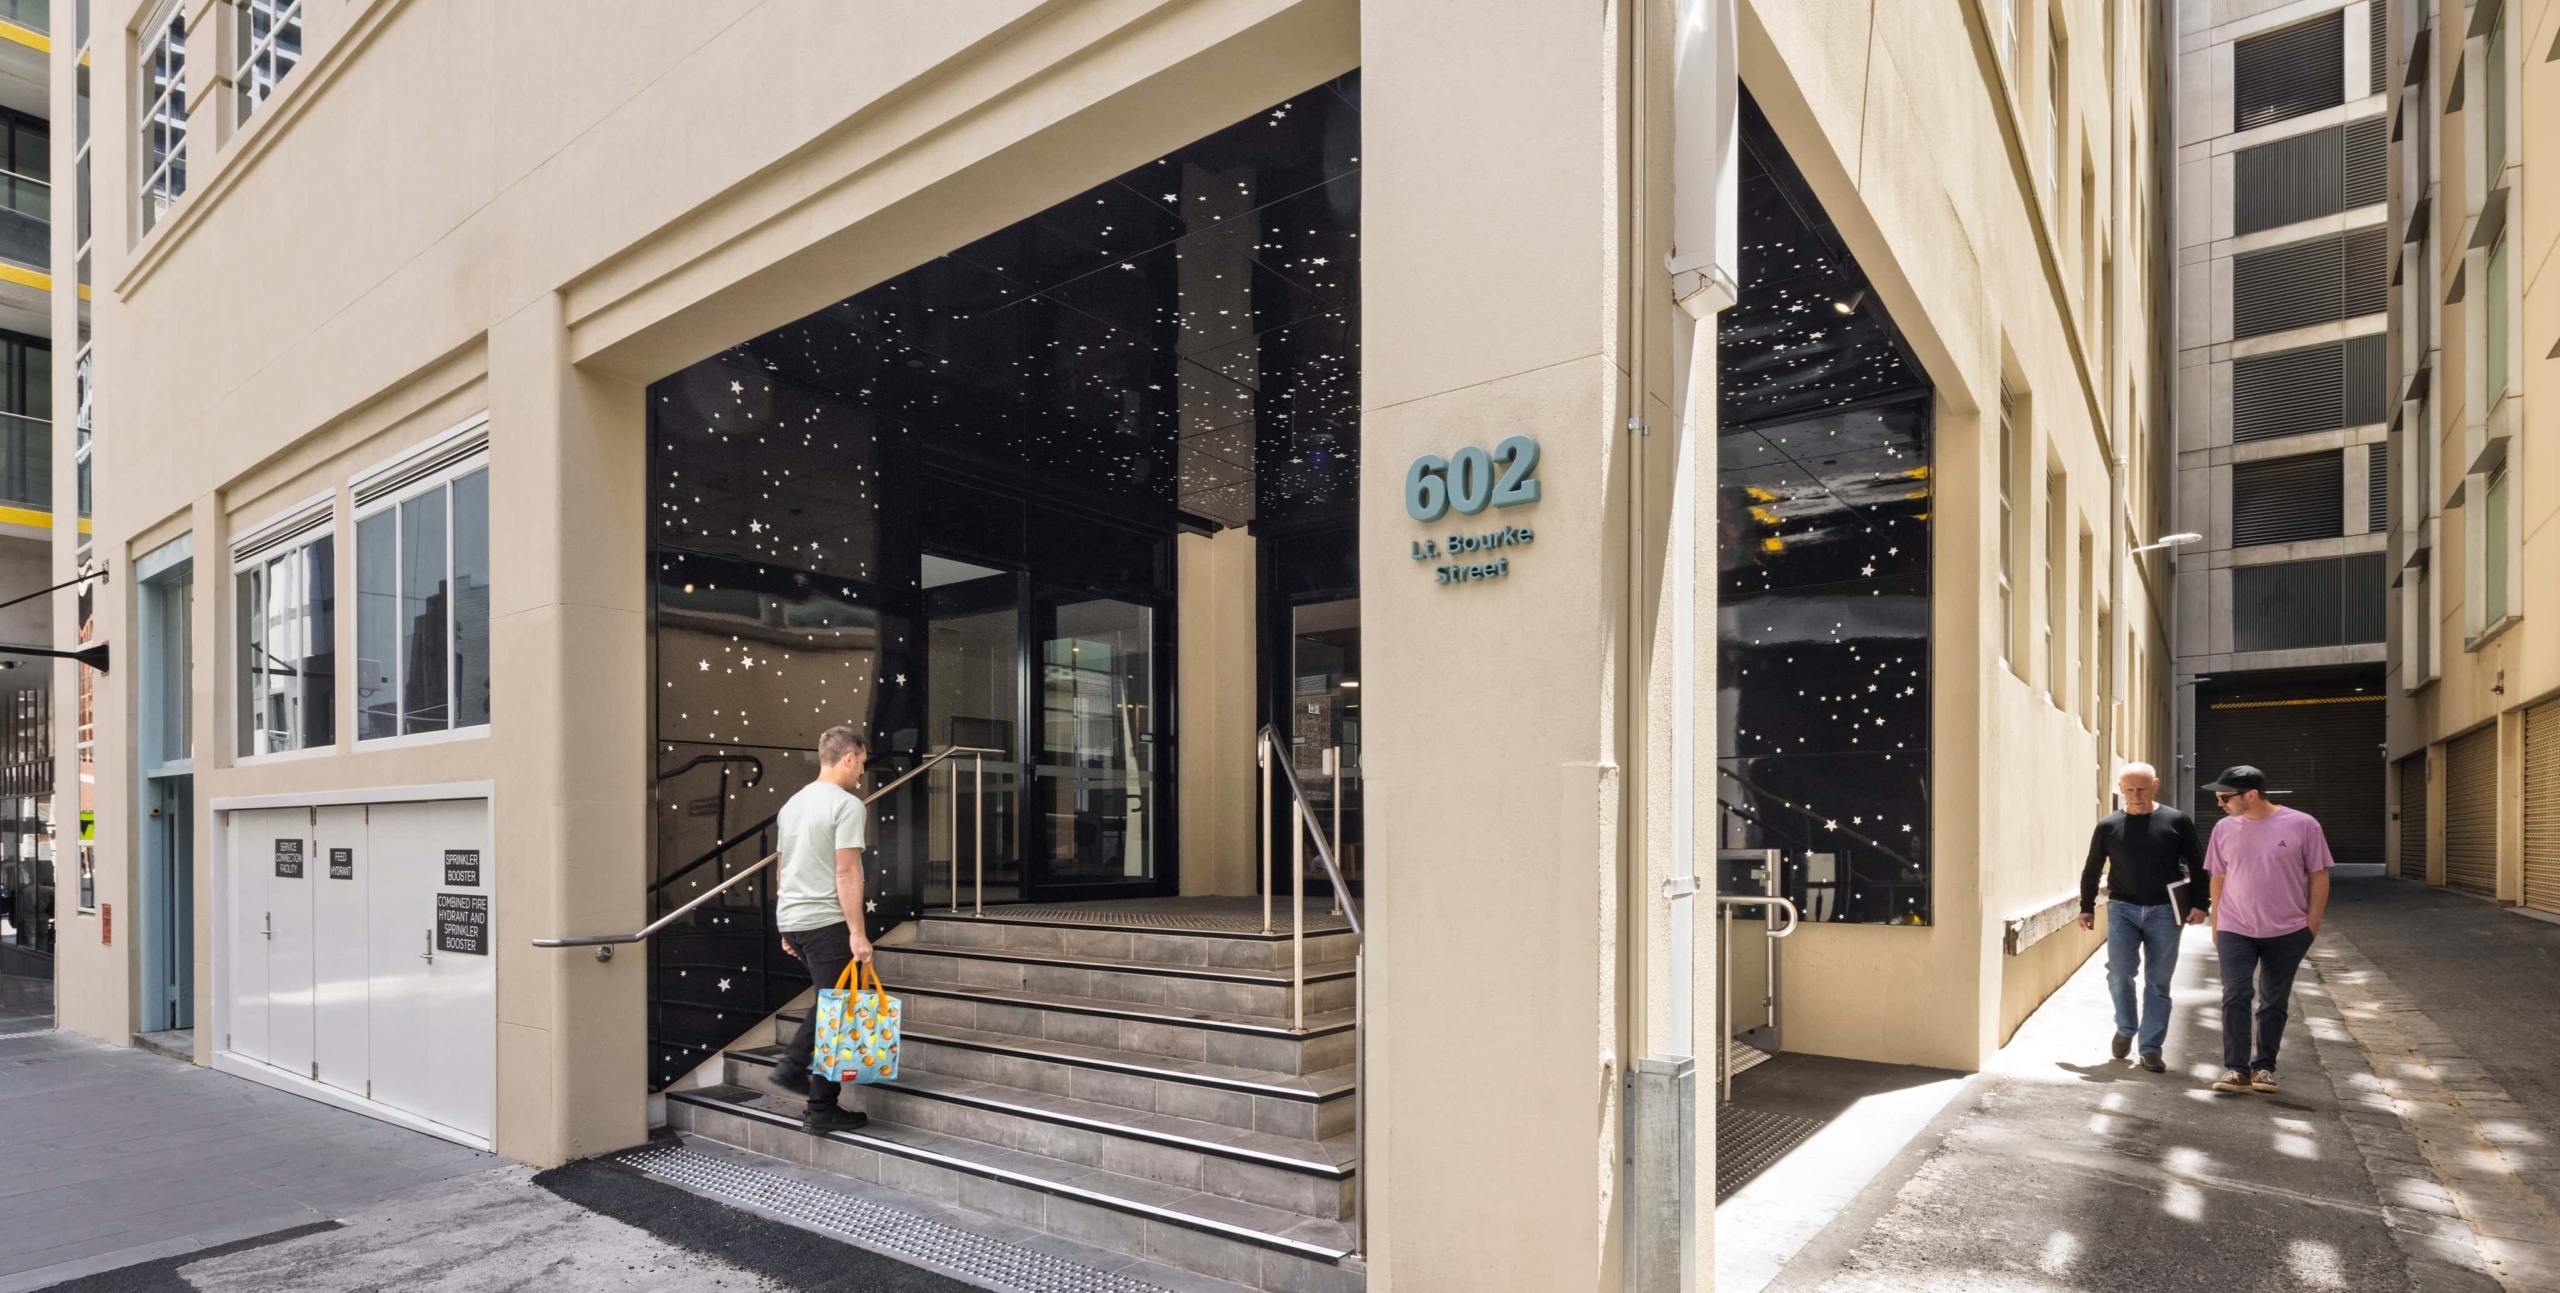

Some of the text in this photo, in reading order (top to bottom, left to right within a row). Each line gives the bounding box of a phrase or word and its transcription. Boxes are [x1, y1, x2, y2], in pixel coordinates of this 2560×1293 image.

[1405, 434, 1541, 523] 602
[1411, 526, 1535, 561] Lt. Bourke
[1435, 557, 1509, 584] Street
[280, 842, 297, 851] SERVICE
[276, 853, 302, 863] CONNECTION
[335, 852, 346, 861] FEED
[445, 854, 478, 865] SPRINKLER
[279, 864, 297, 873] FACILITY
[330, 866, 351, 875] HYDRANT
[447, 870, 476, 882] BOOSTER
[438, 896, 486, 910] COMBINED FIRE
[438, 910, 485, 924] HYDRANT AND
[444, 923, 478, 937] SPRINKLER
[446, 937, 476, 951] BOOSTER
